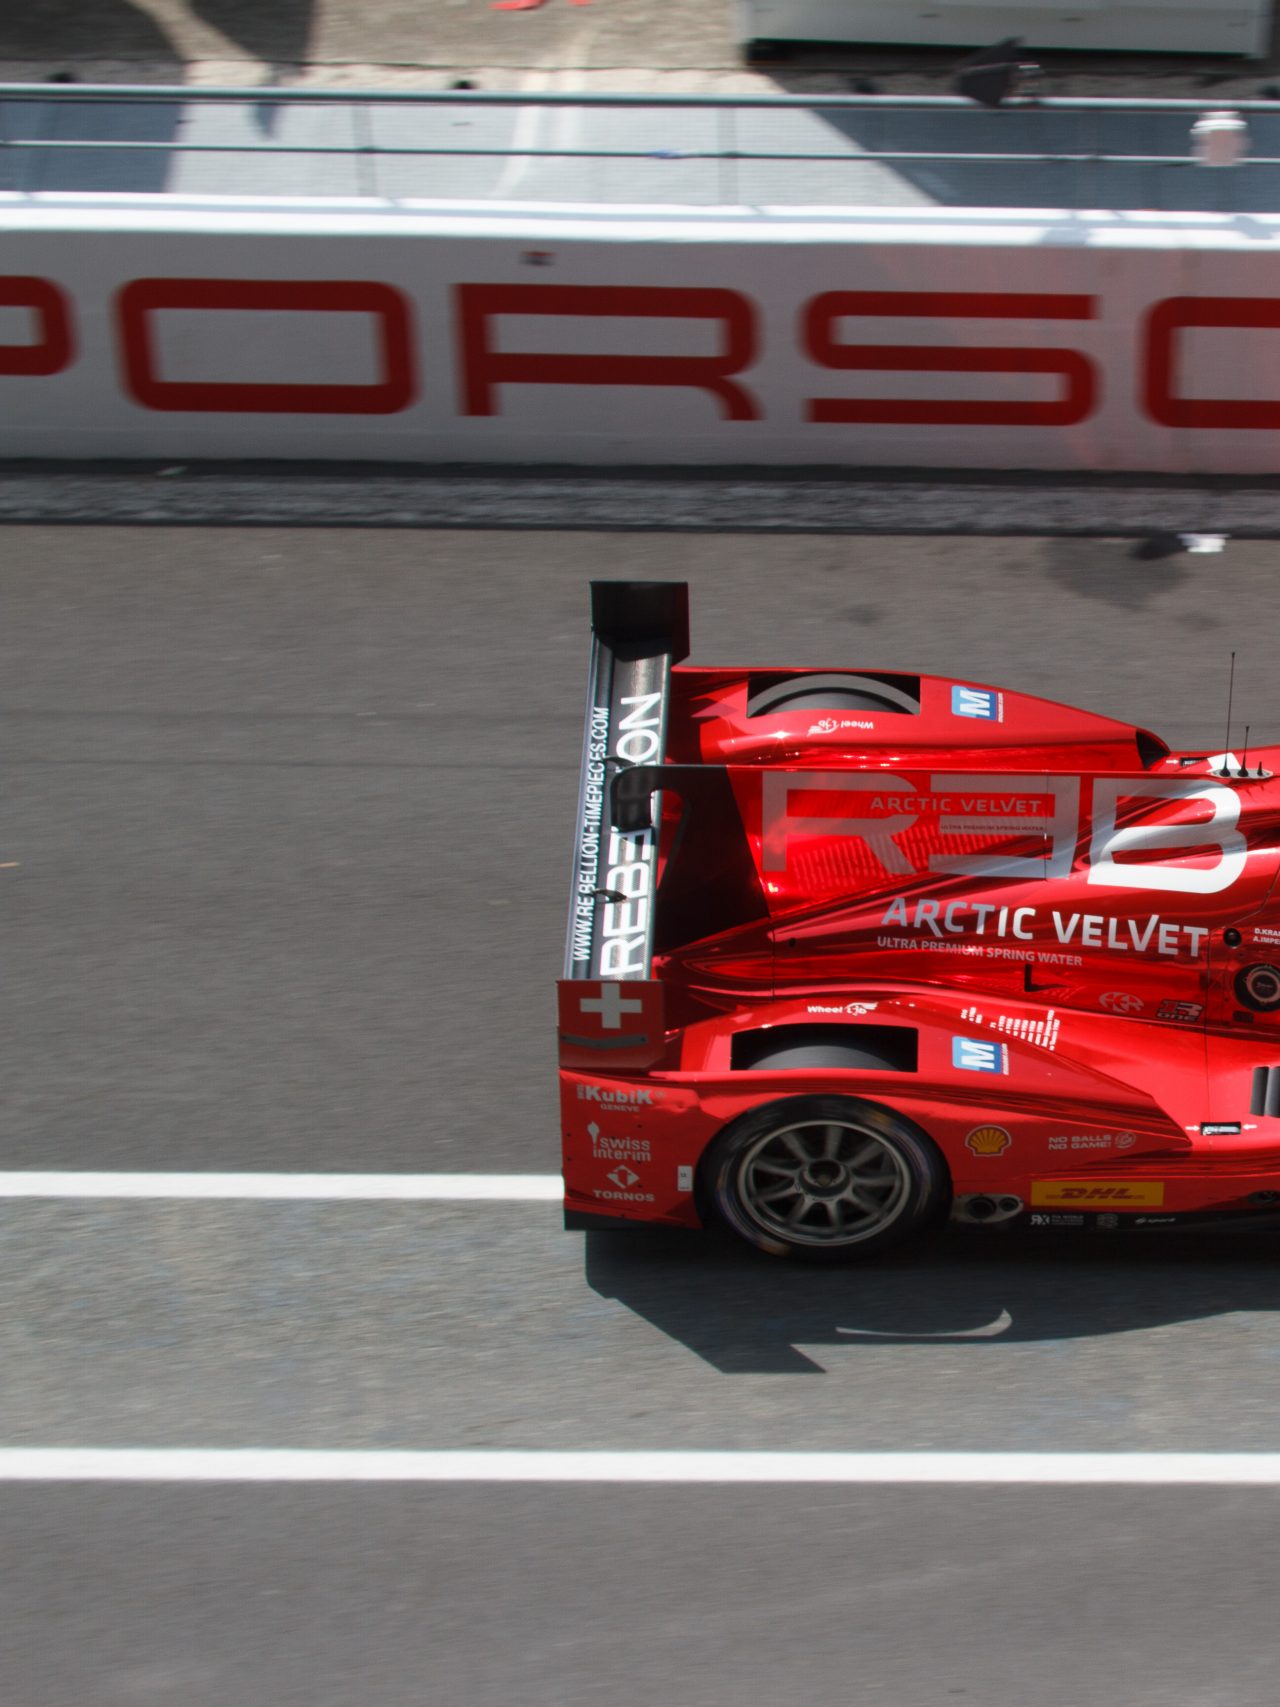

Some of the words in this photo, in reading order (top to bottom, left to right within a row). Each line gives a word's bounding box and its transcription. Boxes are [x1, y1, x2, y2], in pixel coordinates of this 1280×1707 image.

[870, 796, 952, 812] ARCTIC
[961, 797, 1041, 813] VELVET
[881, 897, 1036, 941] ARCTIC
[1052, 911, 1209, 957] VELVET
[877, 935, 918, 951] ULTRA
[921, 939, 984, 957] PREMIUM
[986, 946, 1035, 963] SPRING
[1037, 951, 1083, 966] WATER
[599, 1137, 651, 1151] swiss
[1048, 1136, 1068, 1144] NO
[1072, 1134, 1112, 1143] BALLS
[593, 1147, 651, 1162] interim
[592, 1189, 655, 1202] TORNOS
[1061, 1187, 1135, 1200] DHL
